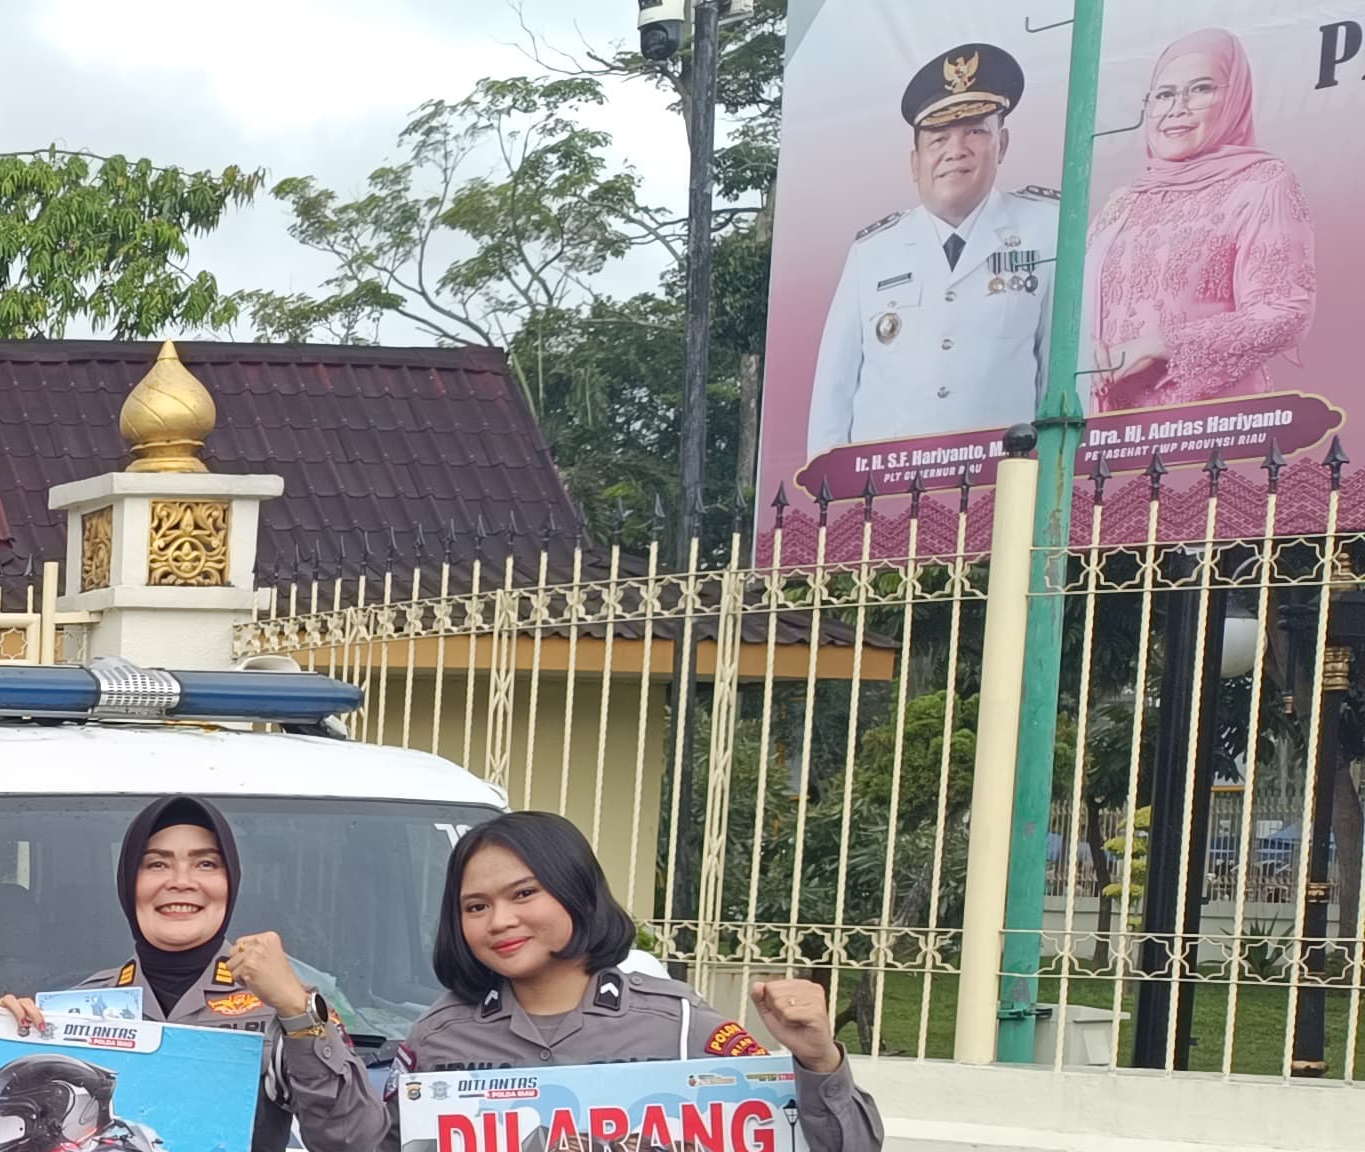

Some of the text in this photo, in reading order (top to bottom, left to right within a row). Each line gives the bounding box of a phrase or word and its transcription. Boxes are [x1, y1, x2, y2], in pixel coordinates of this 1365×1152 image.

[1315, 20, 1365, 90] P
[1090, 410, 1293, 446] Dra. Hj. Adrias Hariyanto
[855, 456, 870, 473] Ir.
[871, 454, 885, 470] H.
[887, 451, 910, 469] S.F.
[912, 444, 987, 467] Hariyanto,
[1085, 445, 1149, 462] PEASEHAT
[1238, 432, 1267, 446] RIAU
[904, 466, 957, 481] GUERNUR
[64, 1024, 137, 1039] DITLANTAS
[458, 1077, 537, 1092] DITLANTAS
